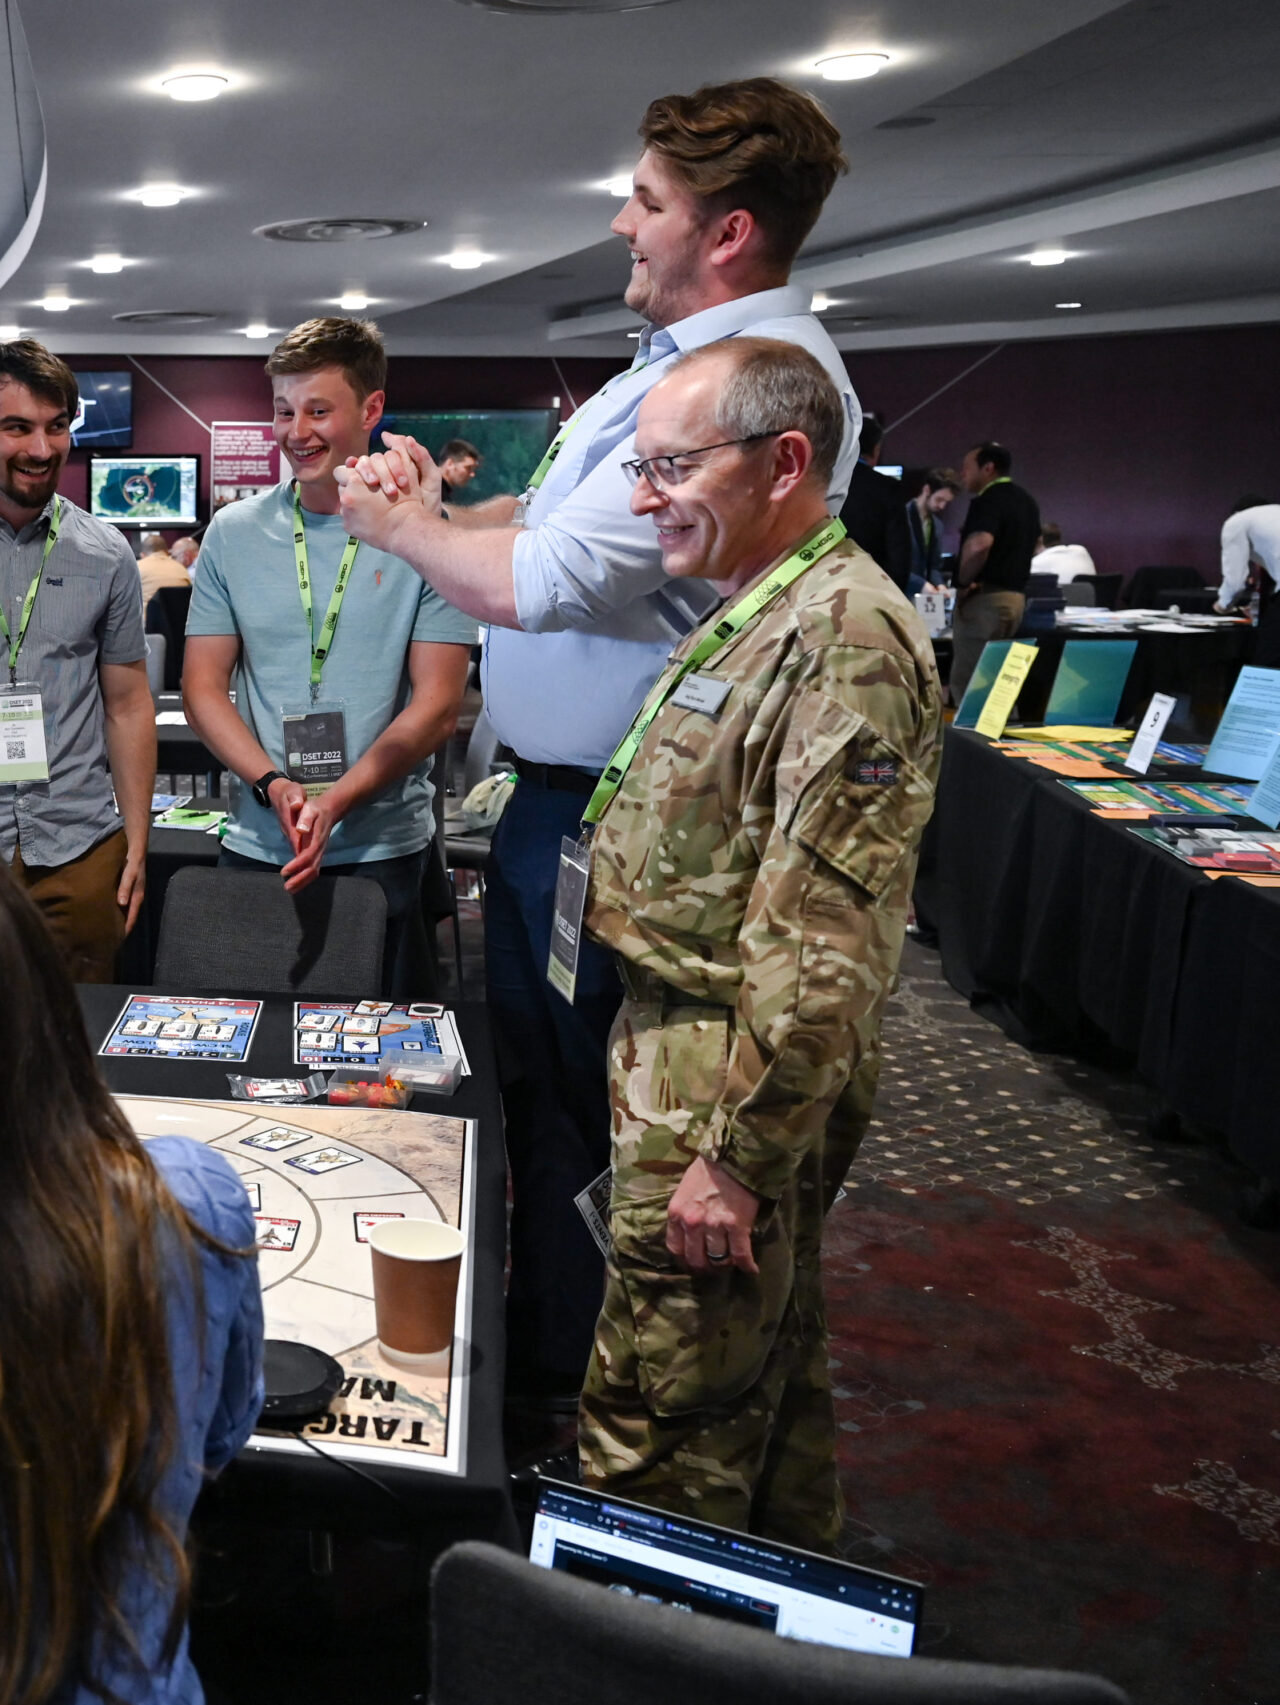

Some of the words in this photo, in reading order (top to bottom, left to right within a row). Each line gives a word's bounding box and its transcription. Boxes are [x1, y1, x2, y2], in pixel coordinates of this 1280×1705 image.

[924, 603, 936, 613] 12
[302, 752, 322, 760] DSET
[323, 751, 341, 759] 2022
